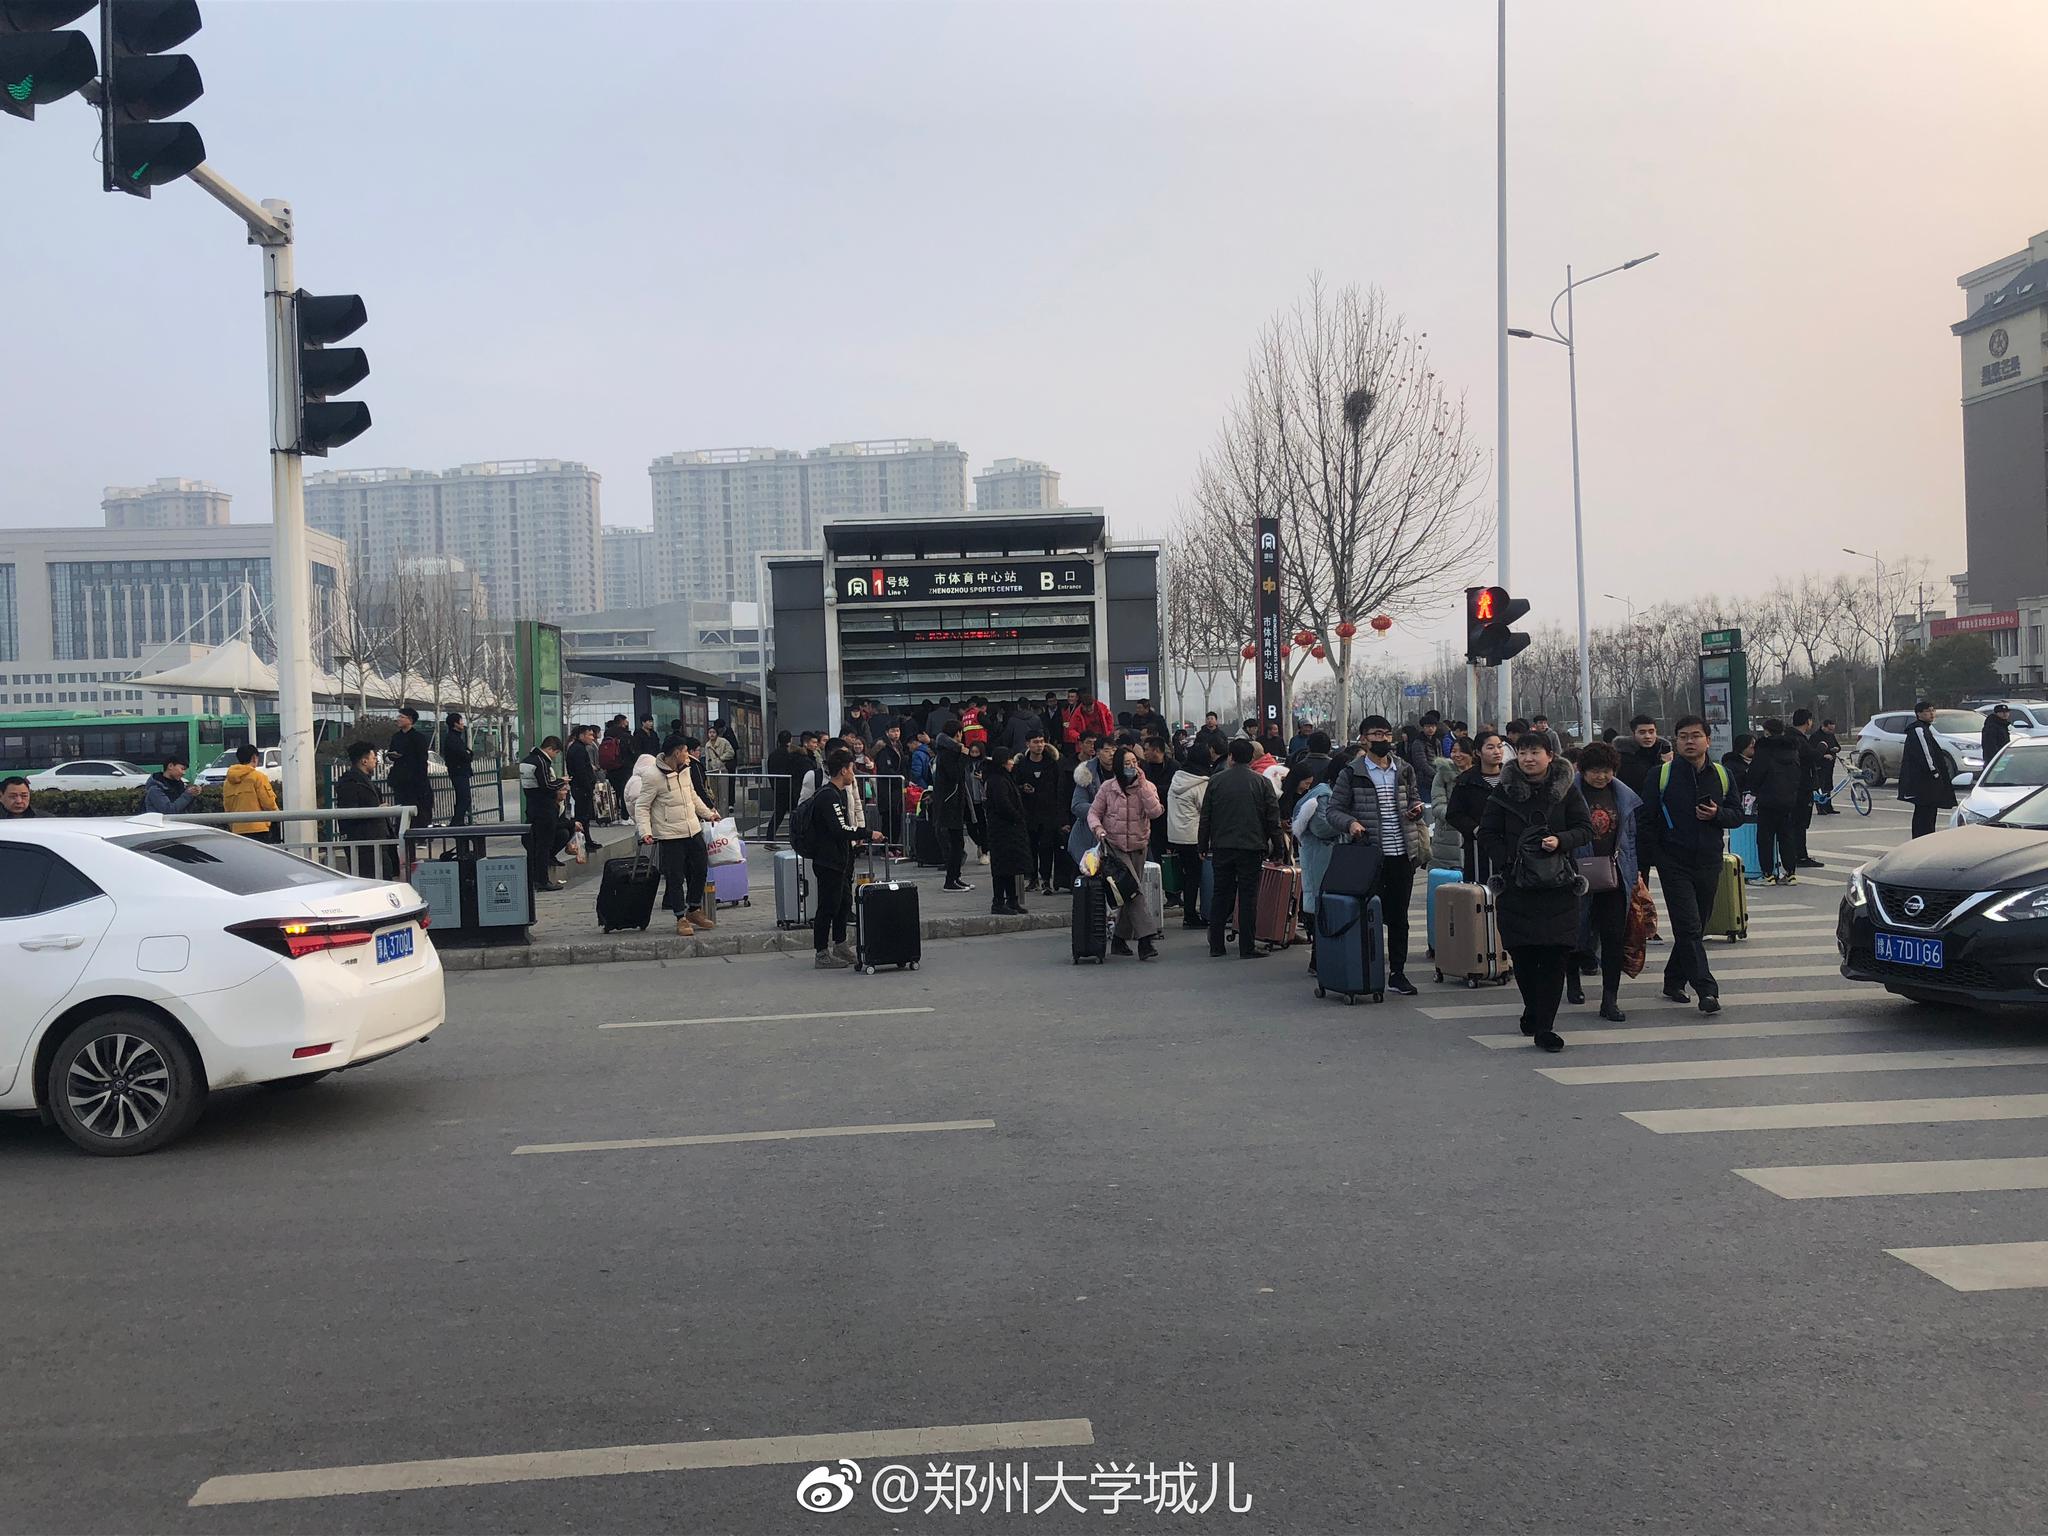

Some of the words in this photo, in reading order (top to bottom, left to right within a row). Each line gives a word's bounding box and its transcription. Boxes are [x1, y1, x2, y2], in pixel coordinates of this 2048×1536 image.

[886, 576, 910, 588] 号线
[934, 571, 1018, 586] 市体育中心站
[1040, 571, 1055, 591] B
[1065, 570, 1076, 582] 口
[928, 587, 969, 595] ZHENGZHOU
[970, 585, 996, 593] SPORTS
[1263, 616, 1273, 680] 市体育中心站
[1268, 705, 1277, 719] B
